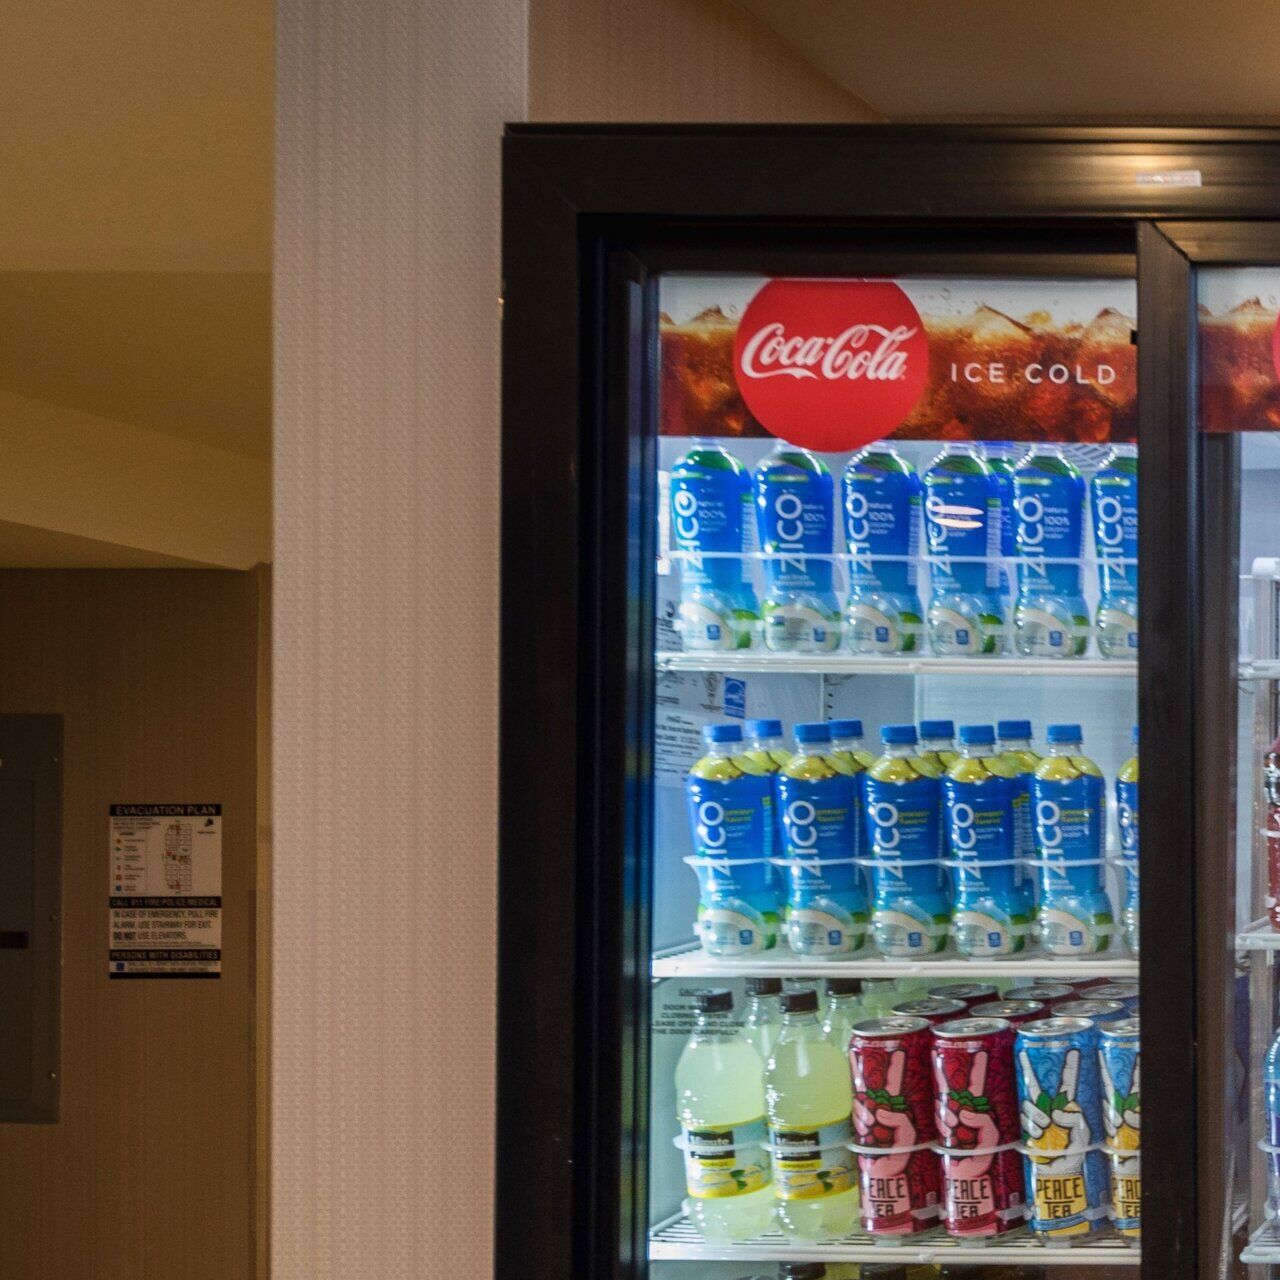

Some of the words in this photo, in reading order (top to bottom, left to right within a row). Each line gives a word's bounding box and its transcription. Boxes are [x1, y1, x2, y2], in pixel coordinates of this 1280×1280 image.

[741, 322, 917, 382] Coca-Cola
[951, 363, 1004, 385] ICE
[1025, 364, 1117, 386] COLD
[868, 511, 895, 522] 100%
[1043, 515, 1070, 526] 100%
[775, 493, 807, 574] ZICO
[1018, 495, 1046, 578] ZICO
[116, 806, 184, 815] EVACUATION
[187, 806, 216, 815] PLAN
[1036, 800, 1067, 878] ZICO
[1036, 1177, 1084, 1200] PEACE
[1046, 1202, 1071, 1218] TEA
